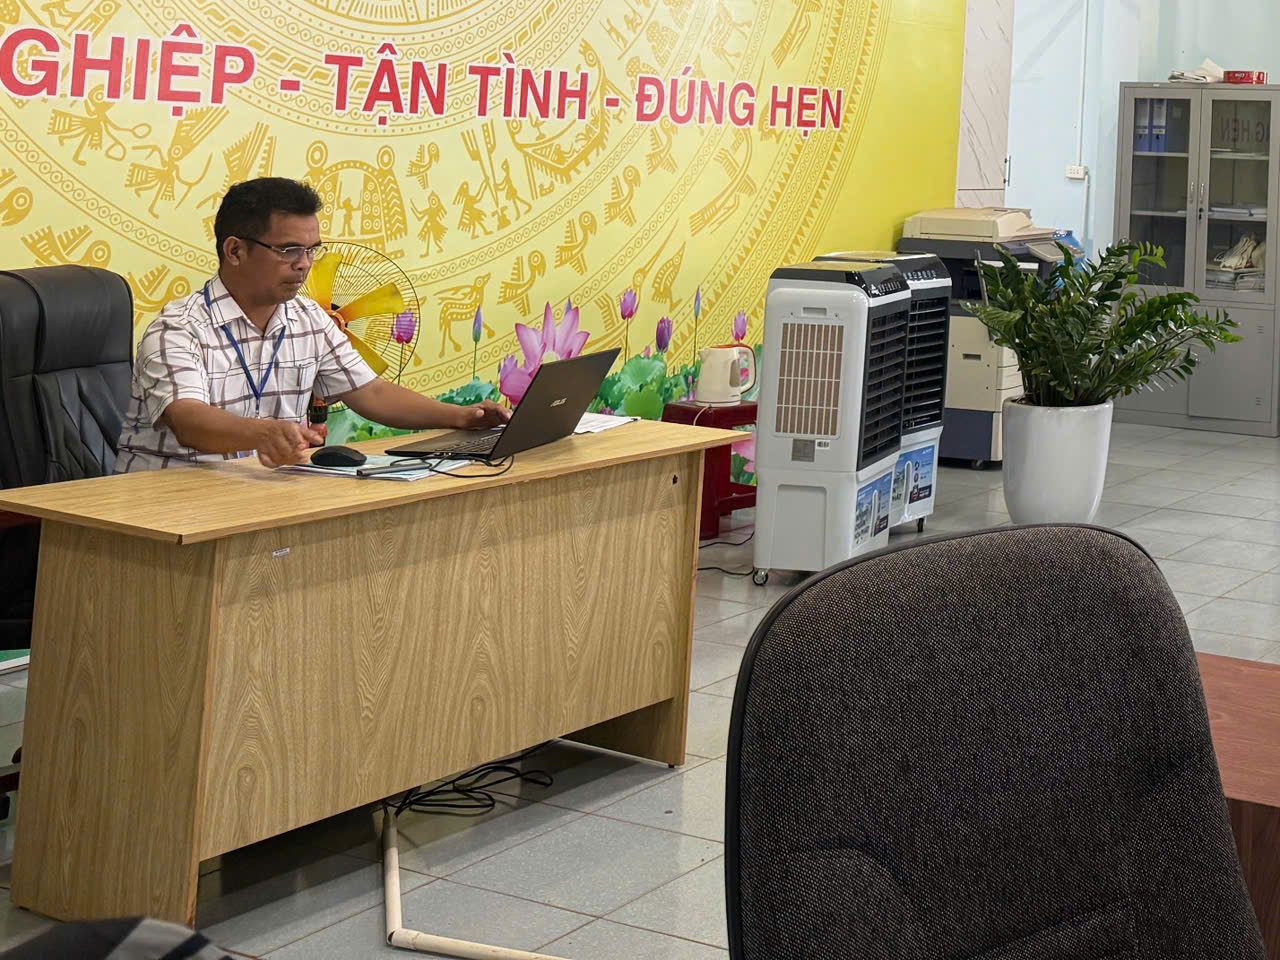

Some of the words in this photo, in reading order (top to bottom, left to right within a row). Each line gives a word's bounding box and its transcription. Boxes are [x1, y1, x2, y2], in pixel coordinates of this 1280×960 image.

[279, 79, 301, 92] -
[325, 42, 447, 125] TẬN
[468, 52, 589, 120] TÌNH
[605, 97, 620, 108] -
[635, 66, 755, 126] ĐÚNG
[769, 85, 843, 137] HẸN
